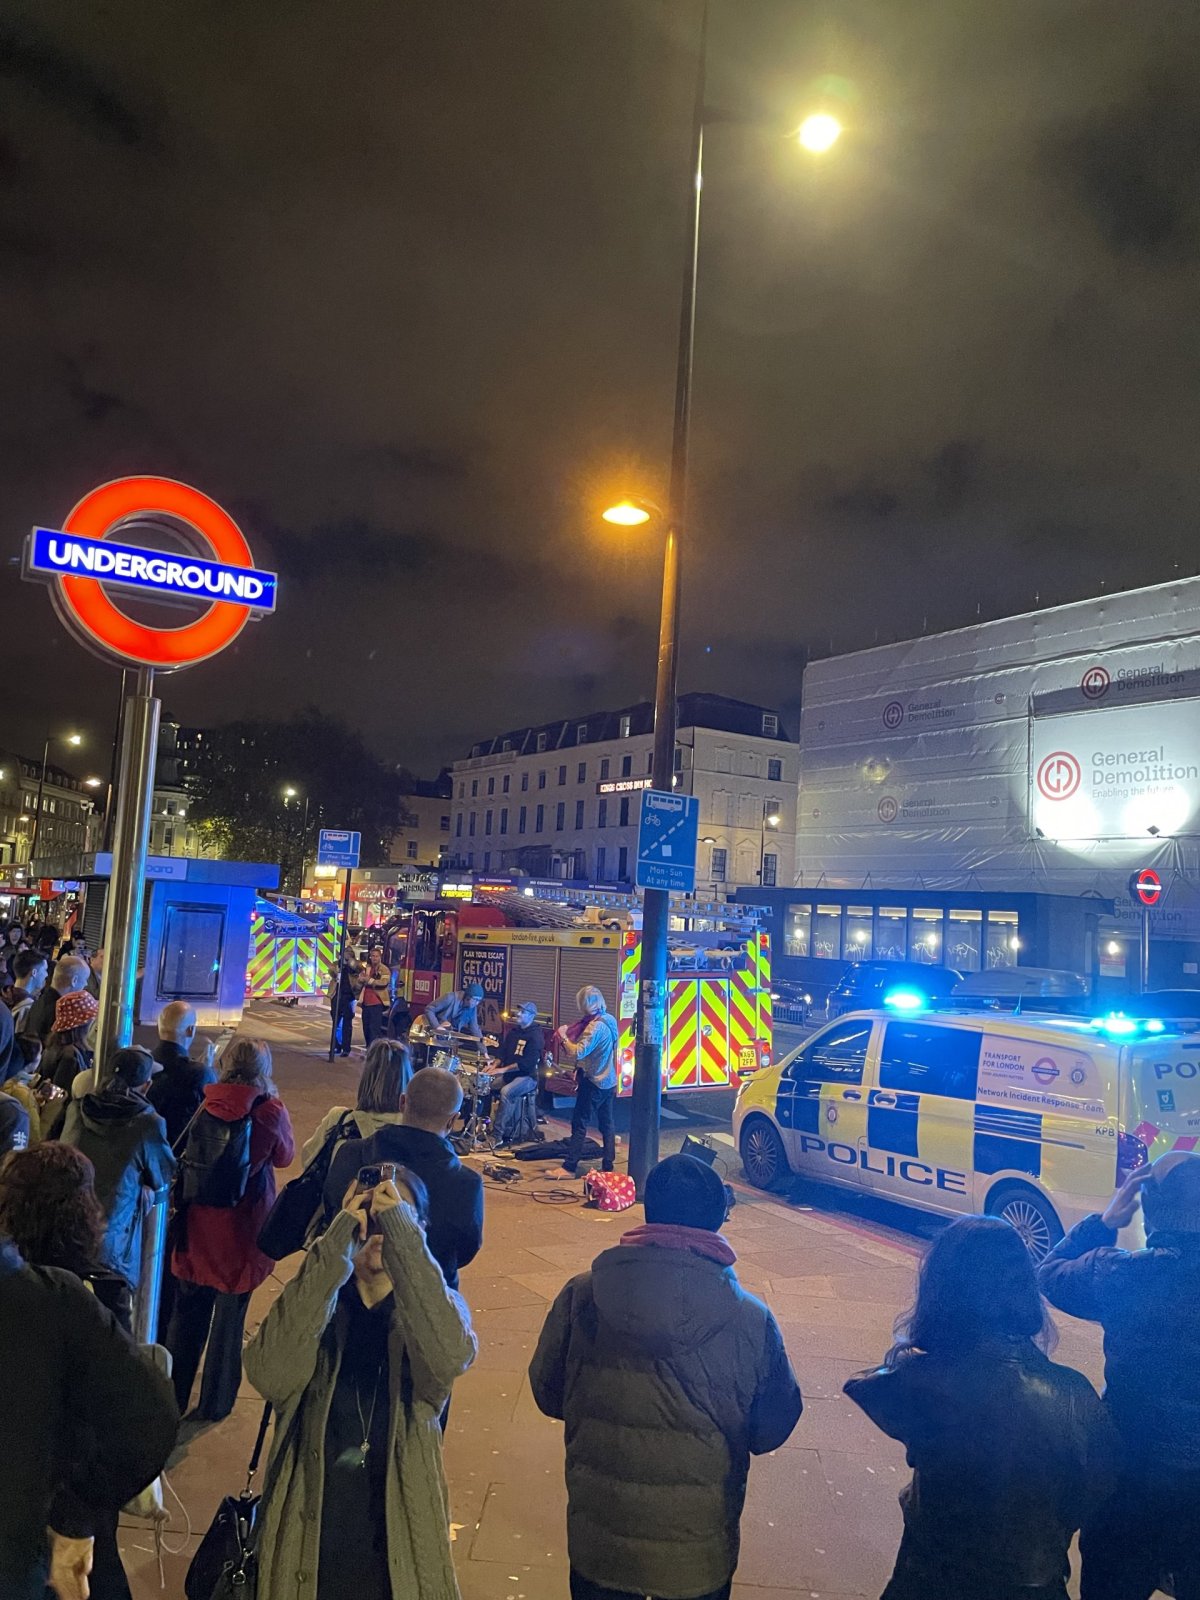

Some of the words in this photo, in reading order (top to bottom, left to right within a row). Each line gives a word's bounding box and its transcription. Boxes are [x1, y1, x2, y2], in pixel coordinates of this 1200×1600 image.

[48, 539, 263, 599] UNDERGROUND
[1117, 662, 1163, 679] General
[1117, 672, 1185, 691] Demolition
[907, 699, 942, 713] General
[908, 708, 956, 723] Demolition
[1091, 745, 1164, 766] General
[1092, 764, 1198, 785] Demolition
[1092, 787, 1129, 798] Enabling
[1130, 787, 1145, 796] the
[650, 866, 665, 875] Mon
[670, 868, 683, 877] Sun
[646, 876, 655, 884] At
[656, 879, 668, 887] any
[511, 933, 555, 943] london-fire.gov.uk
[463, 960, 481, 975] GET
[483, 961, 504, 977] OUT
[484, 978, 504, 992] OUT
[984, 1052, 1021, 1062] TRANSPORT
[983, 1060, 996, 1068] FOR
[996, 1062, 1025, 1071] LONDON
[1154, 1061, 1200, 1080] PO
[977, 1087, 1008, 1098] Network
[1009, 1090, 1040, 1103] Incident
[1041, 1096, 1079, 1109] Response
[1081, 1102, 1104, 1112] Team
[1095, 1126, 1115, 1137] KPB
[800, 1135, 967, 1195] POLICE
